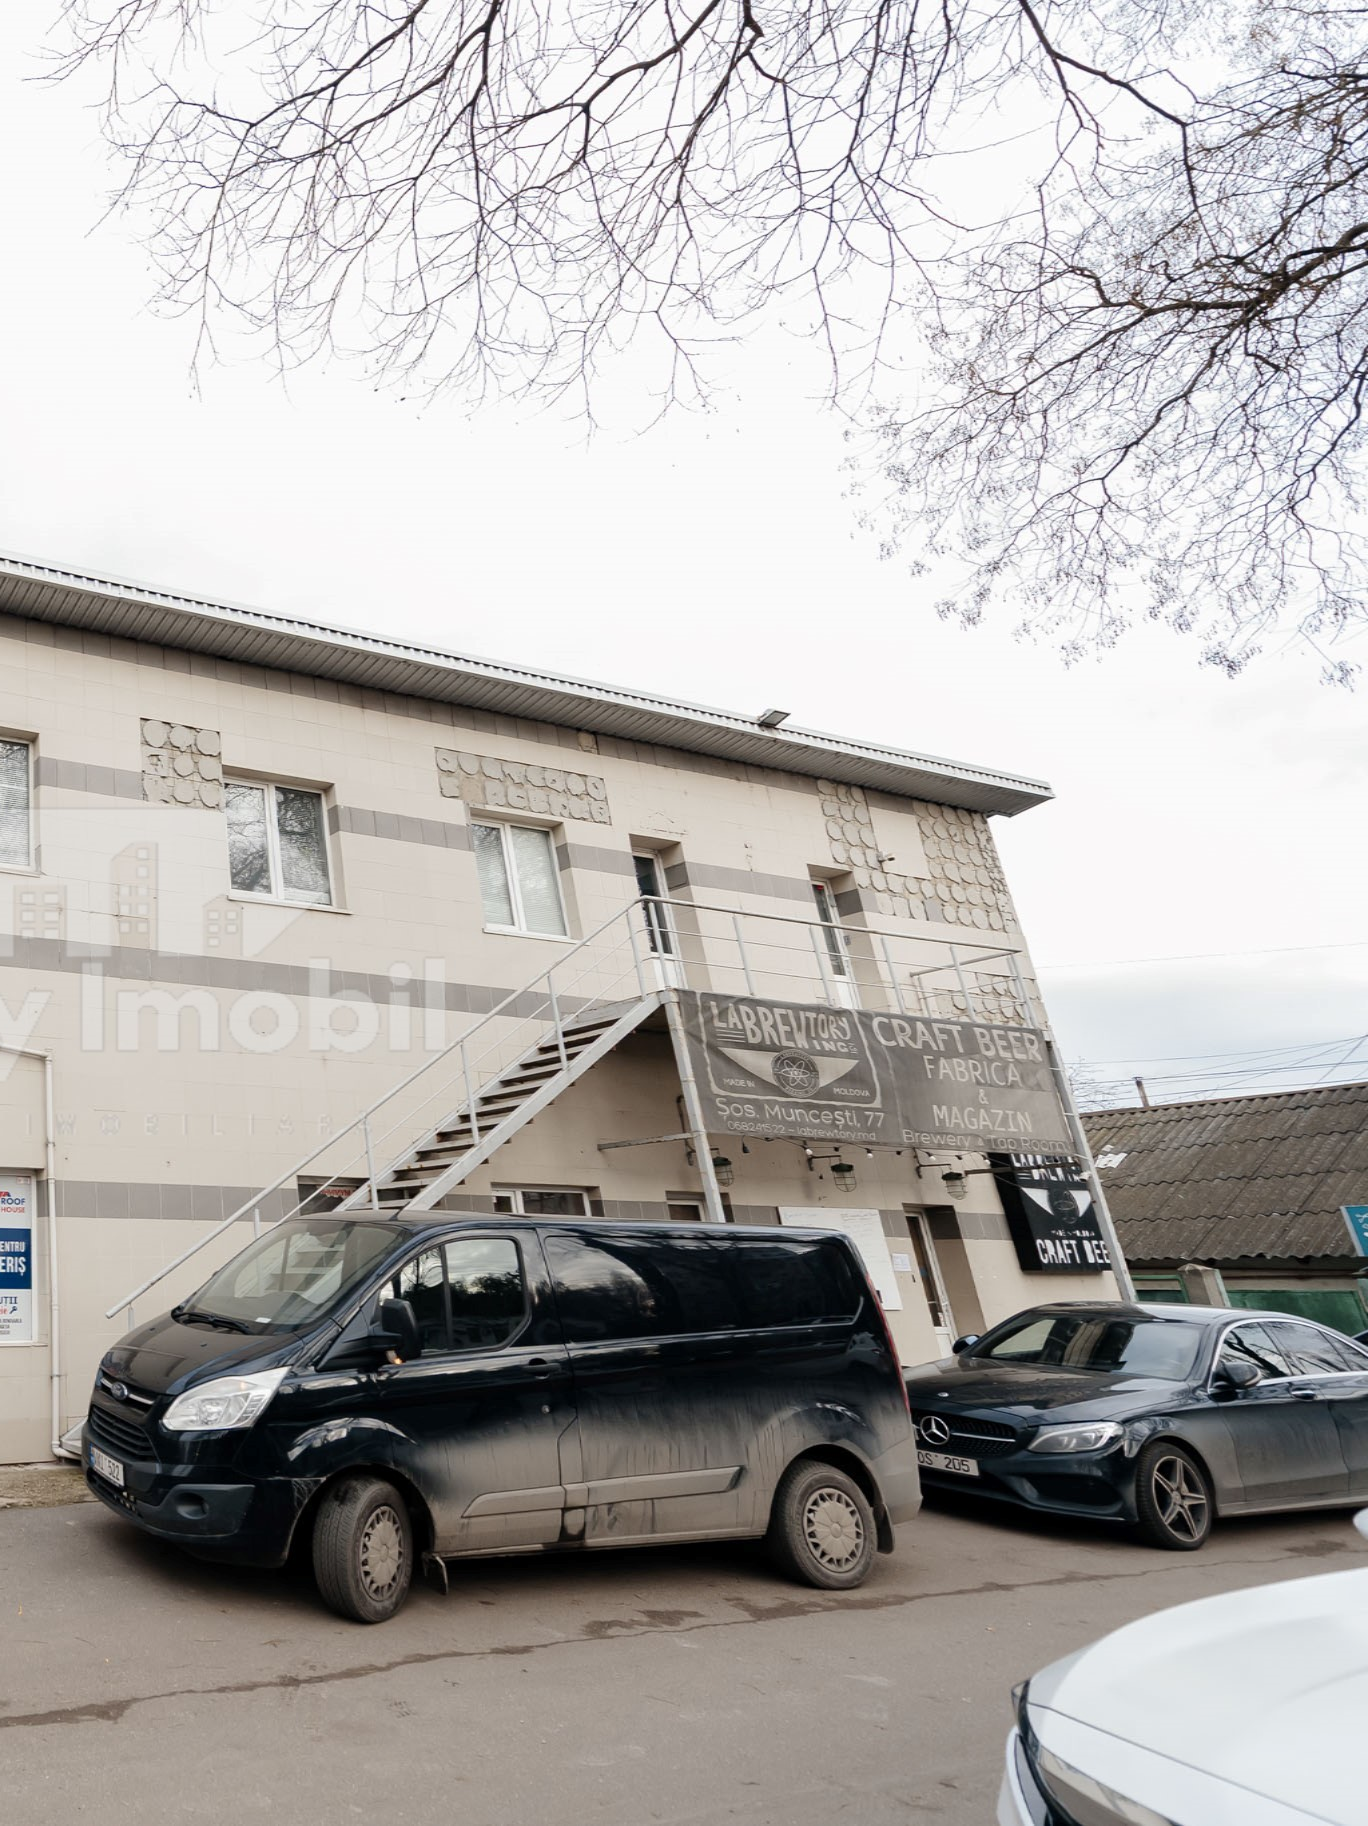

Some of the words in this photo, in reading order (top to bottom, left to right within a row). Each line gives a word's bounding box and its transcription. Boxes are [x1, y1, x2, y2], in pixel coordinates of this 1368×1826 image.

[872, 1017, 965, 1053] CRAFT
[973, 1027, 1042, 1062] BEER
[723, 1078, 746, 1087] MADE
[833, 1087, 870, 1097] MOLDOVA
[978, 1089, 989, 1105] &
[864, 1111, 884, 1128] 77
[932, 1105, 1033, 1133] MAGAZIN
[903, 1129, 972, 1146] Brewery
[1021, 1137, 1066, 1151] Room
[0, 1197, 26, 1205] ROOF
[1036, 1239, 1080, 1264] CRAFT
[1083, 1240, 1111, 1263] BEE
[944, 1456, 971, 1473] 205
